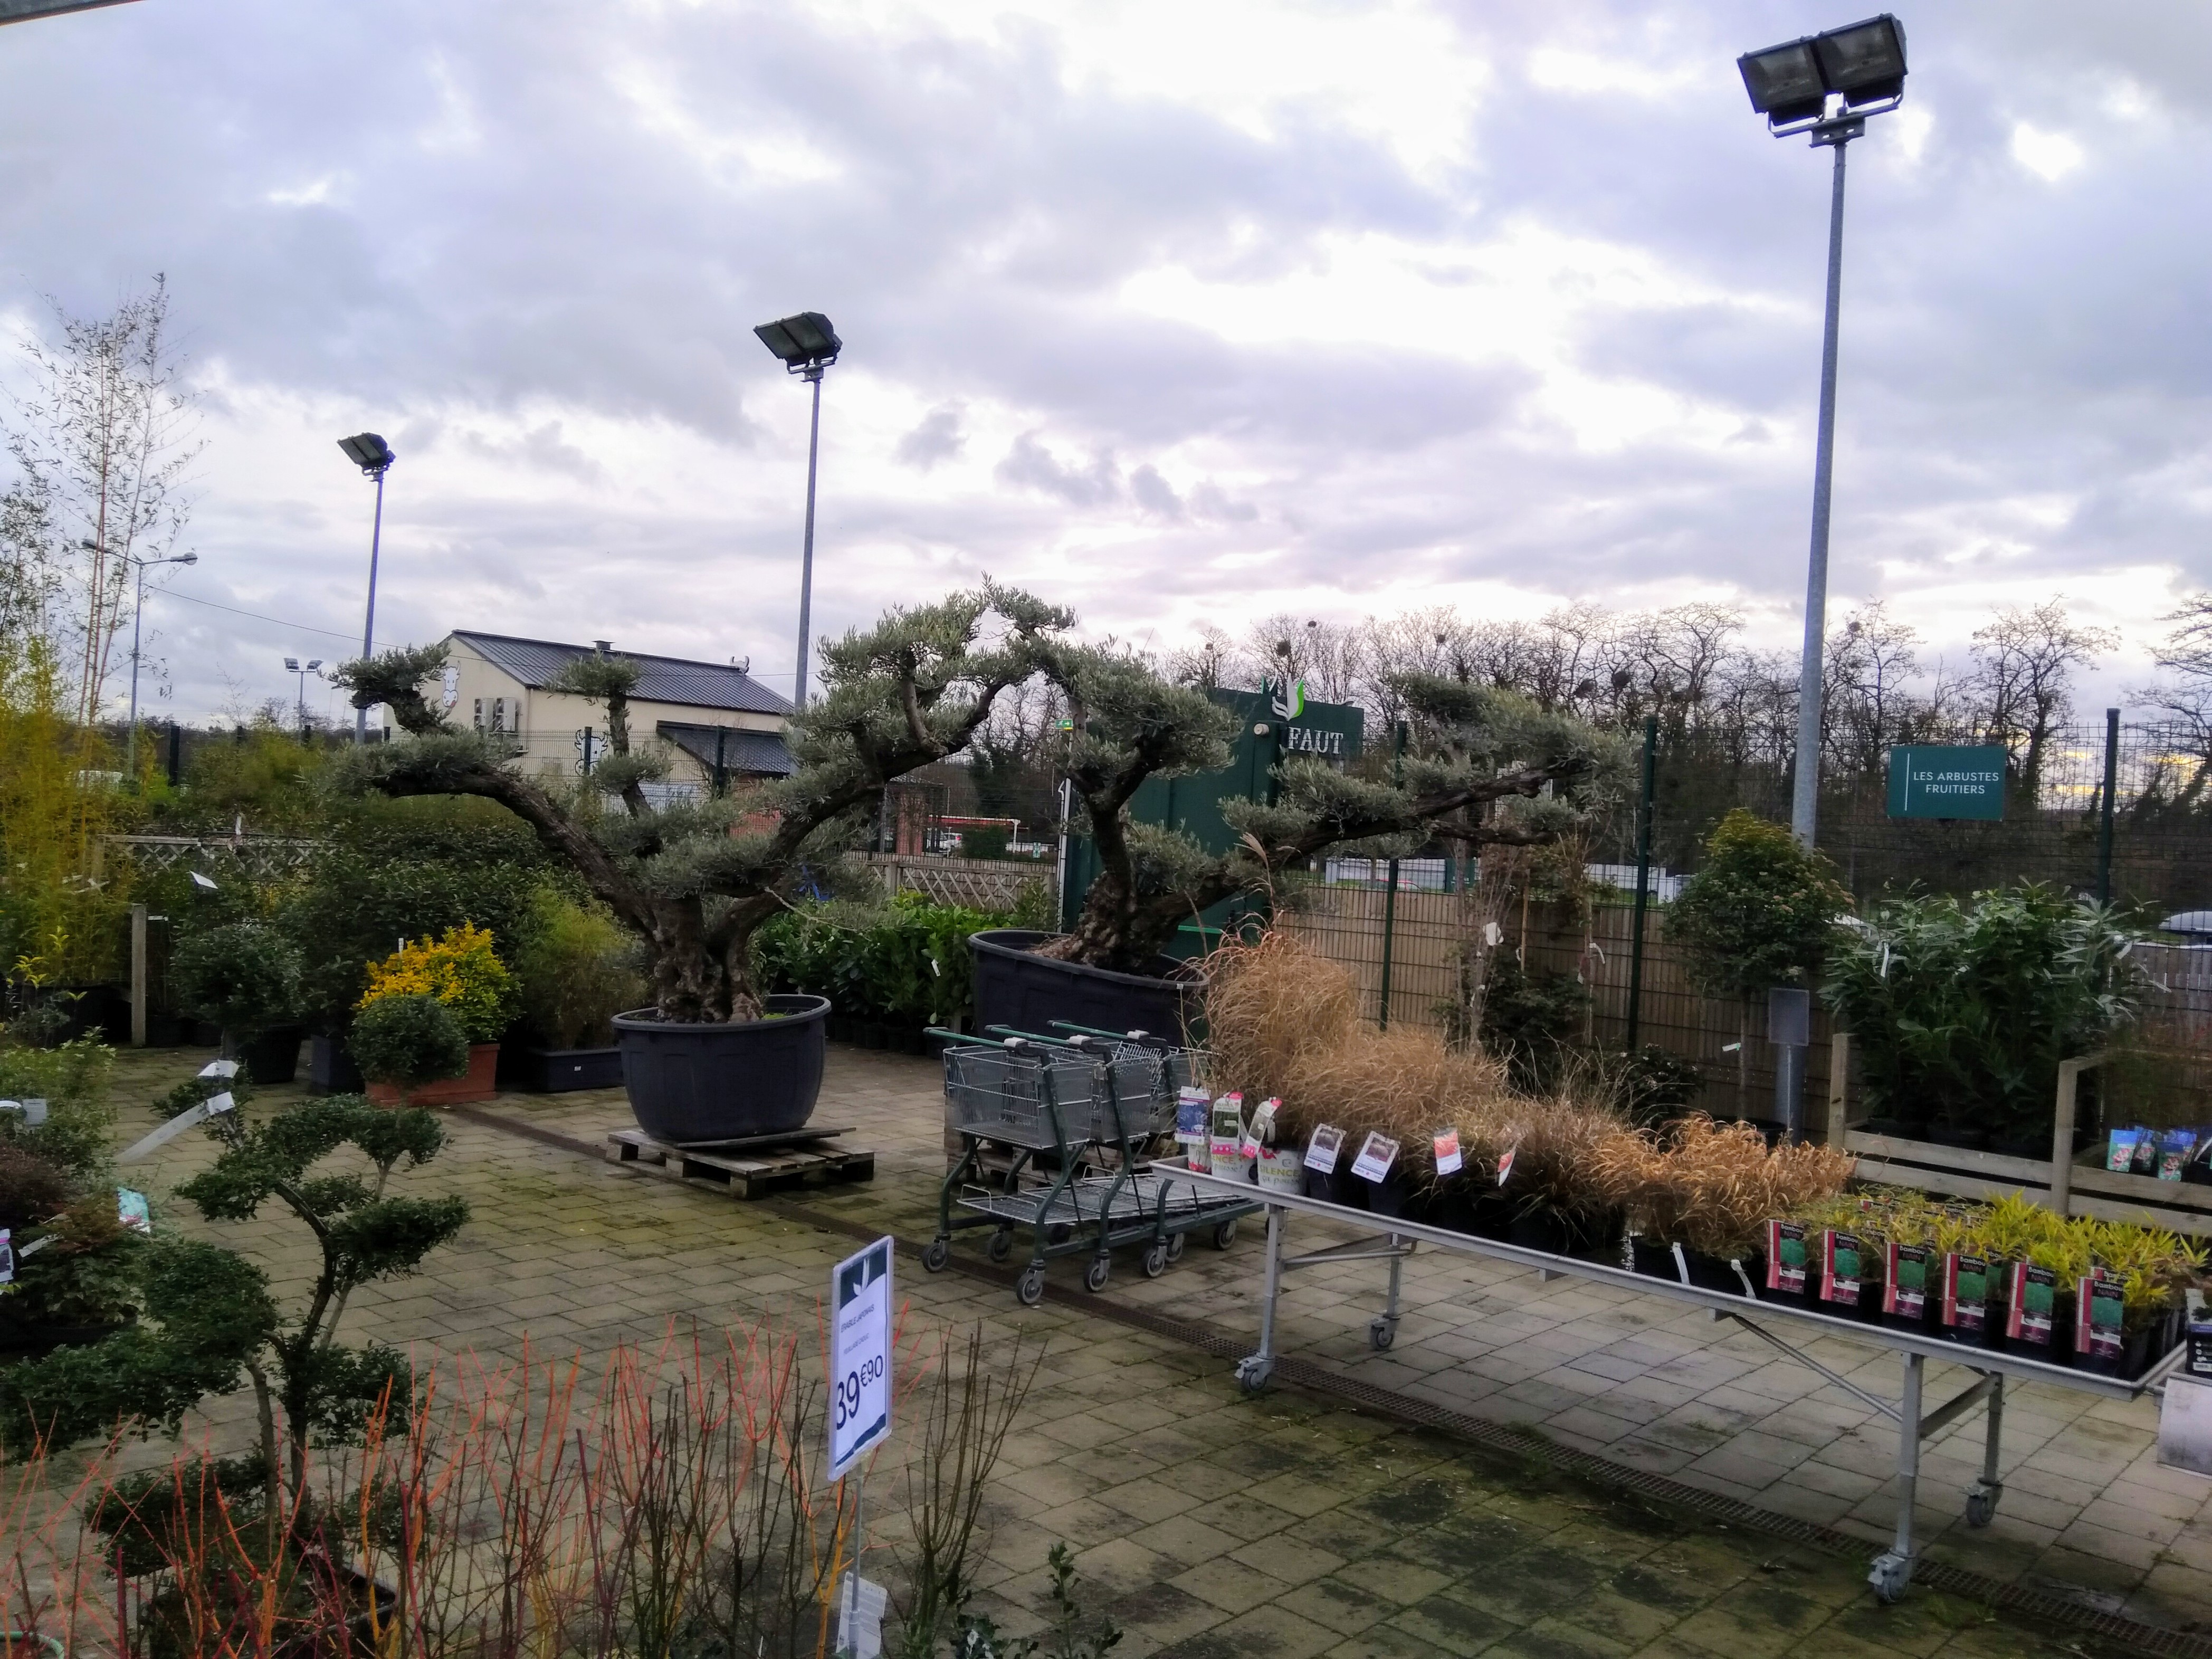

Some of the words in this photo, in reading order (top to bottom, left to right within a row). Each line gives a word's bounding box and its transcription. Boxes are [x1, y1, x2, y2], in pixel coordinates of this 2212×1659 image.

[1913, 771, 1933, 781] LES
[1937, 772, 1999, 781] ARBUSTES
[1925, 784, 1985, 794] FRUITIERS
[1781, 1223, 1803, 1234] Bambou
[1836, 1233, 1858, 1243] Bambou
[1900, 1245, 1925, 1255] Bambou
[1960, 1256, 1986, 1266] Bambou
[2028, 1266, 2054, 1277] Bambou
[2094, 1280, 2123, 1292] Bambou
